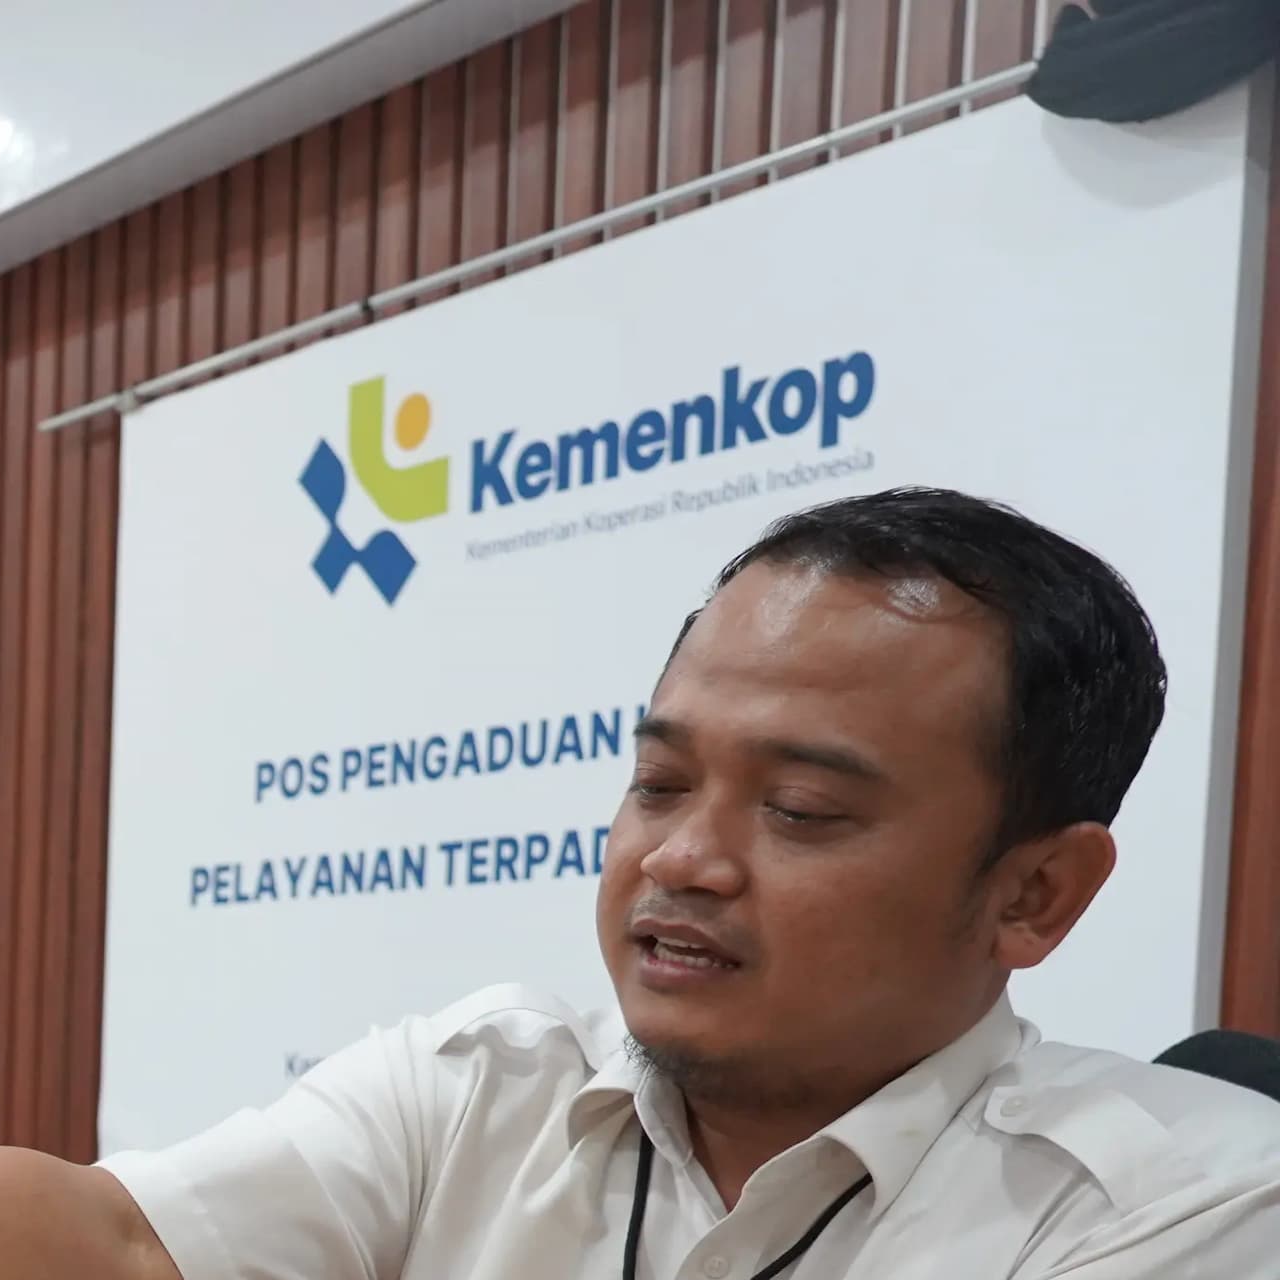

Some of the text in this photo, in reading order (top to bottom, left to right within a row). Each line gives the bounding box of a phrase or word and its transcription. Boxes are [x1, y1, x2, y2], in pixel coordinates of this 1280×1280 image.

[469, 351, 876, 514] Kemenkop
[466, 447, 875, 561] Kementerian Koperasi Republik Indonesia
[255, 708, 621, 803] POS PENGADUAN
[190, 844, 427, 906] PELAYANAN
